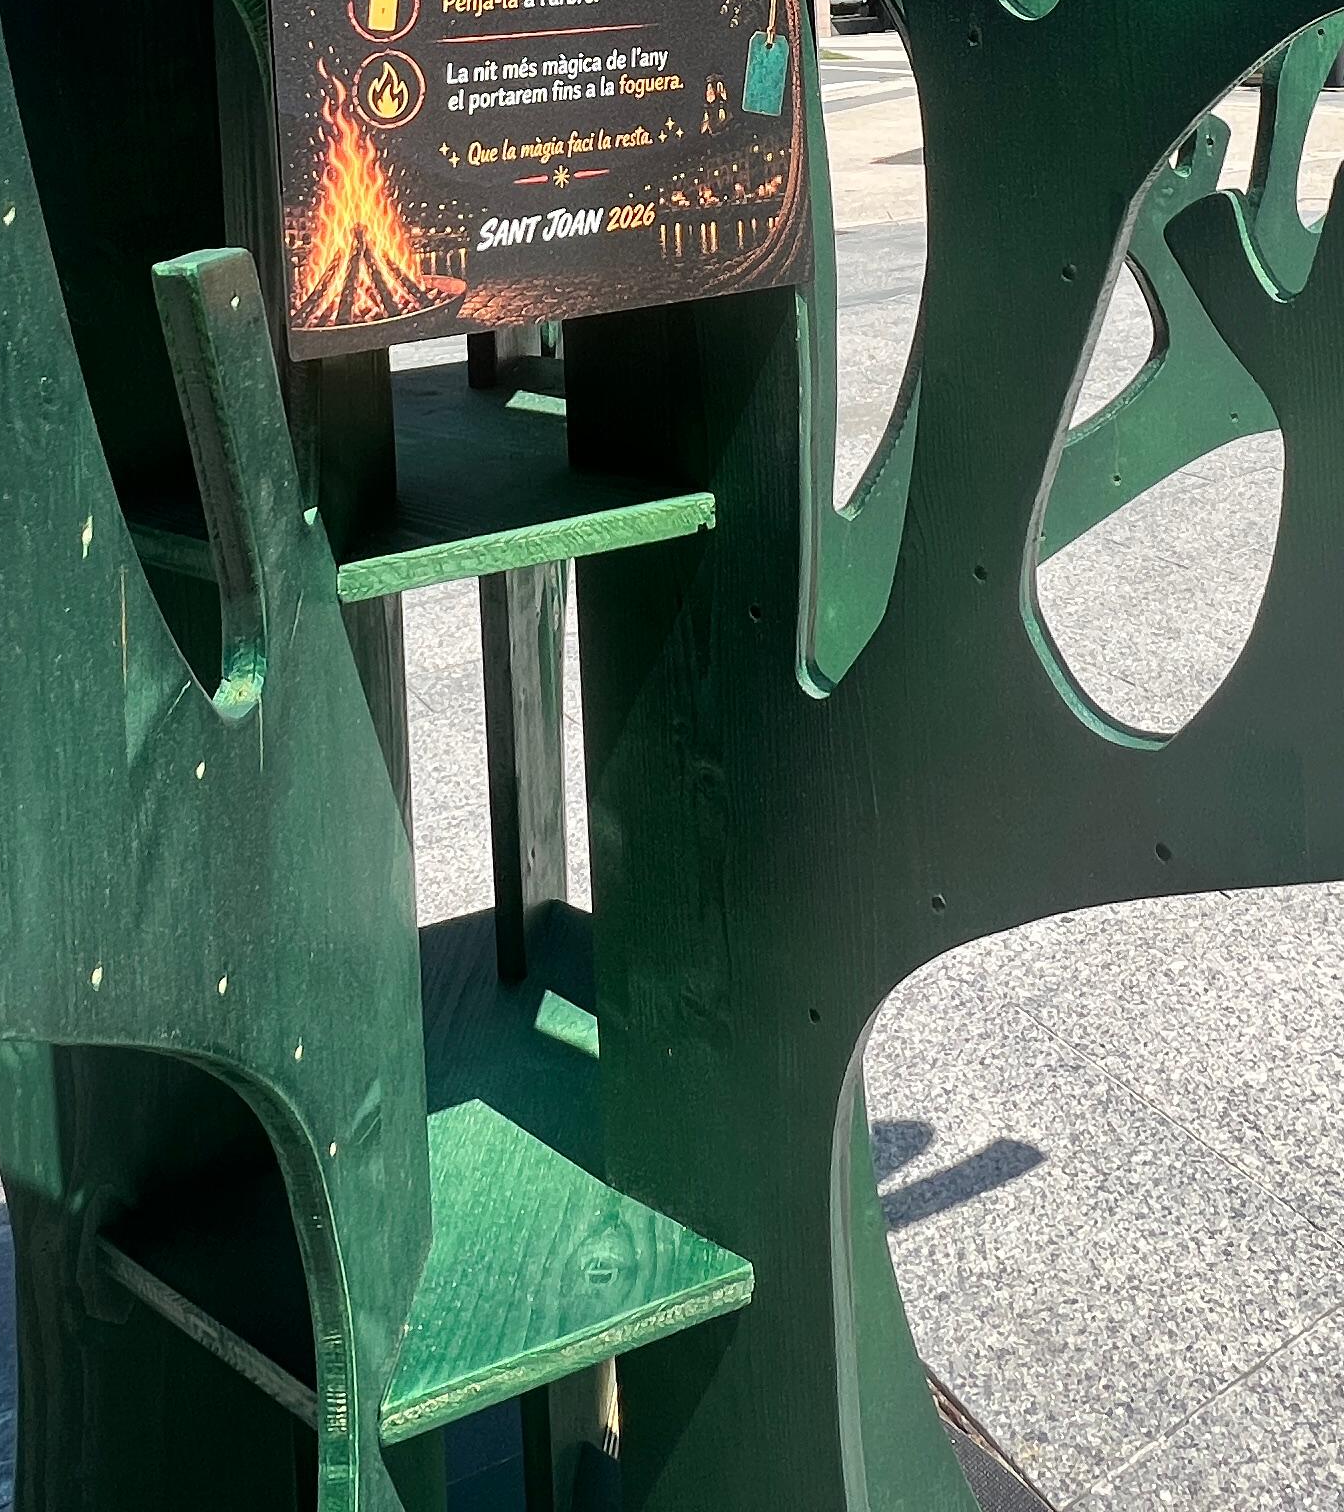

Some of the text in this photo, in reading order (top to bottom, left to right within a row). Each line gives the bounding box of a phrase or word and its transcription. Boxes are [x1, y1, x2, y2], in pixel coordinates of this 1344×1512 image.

[446, 47, 668, 85] La nit més màgica de l'any
[447, 73, 684, 115] el portarem fins a la foguera.
[467, 125, 653, 166] Que la màgia faci la resta.
[476, 202, 656, 252] SANT JOAN 2026
